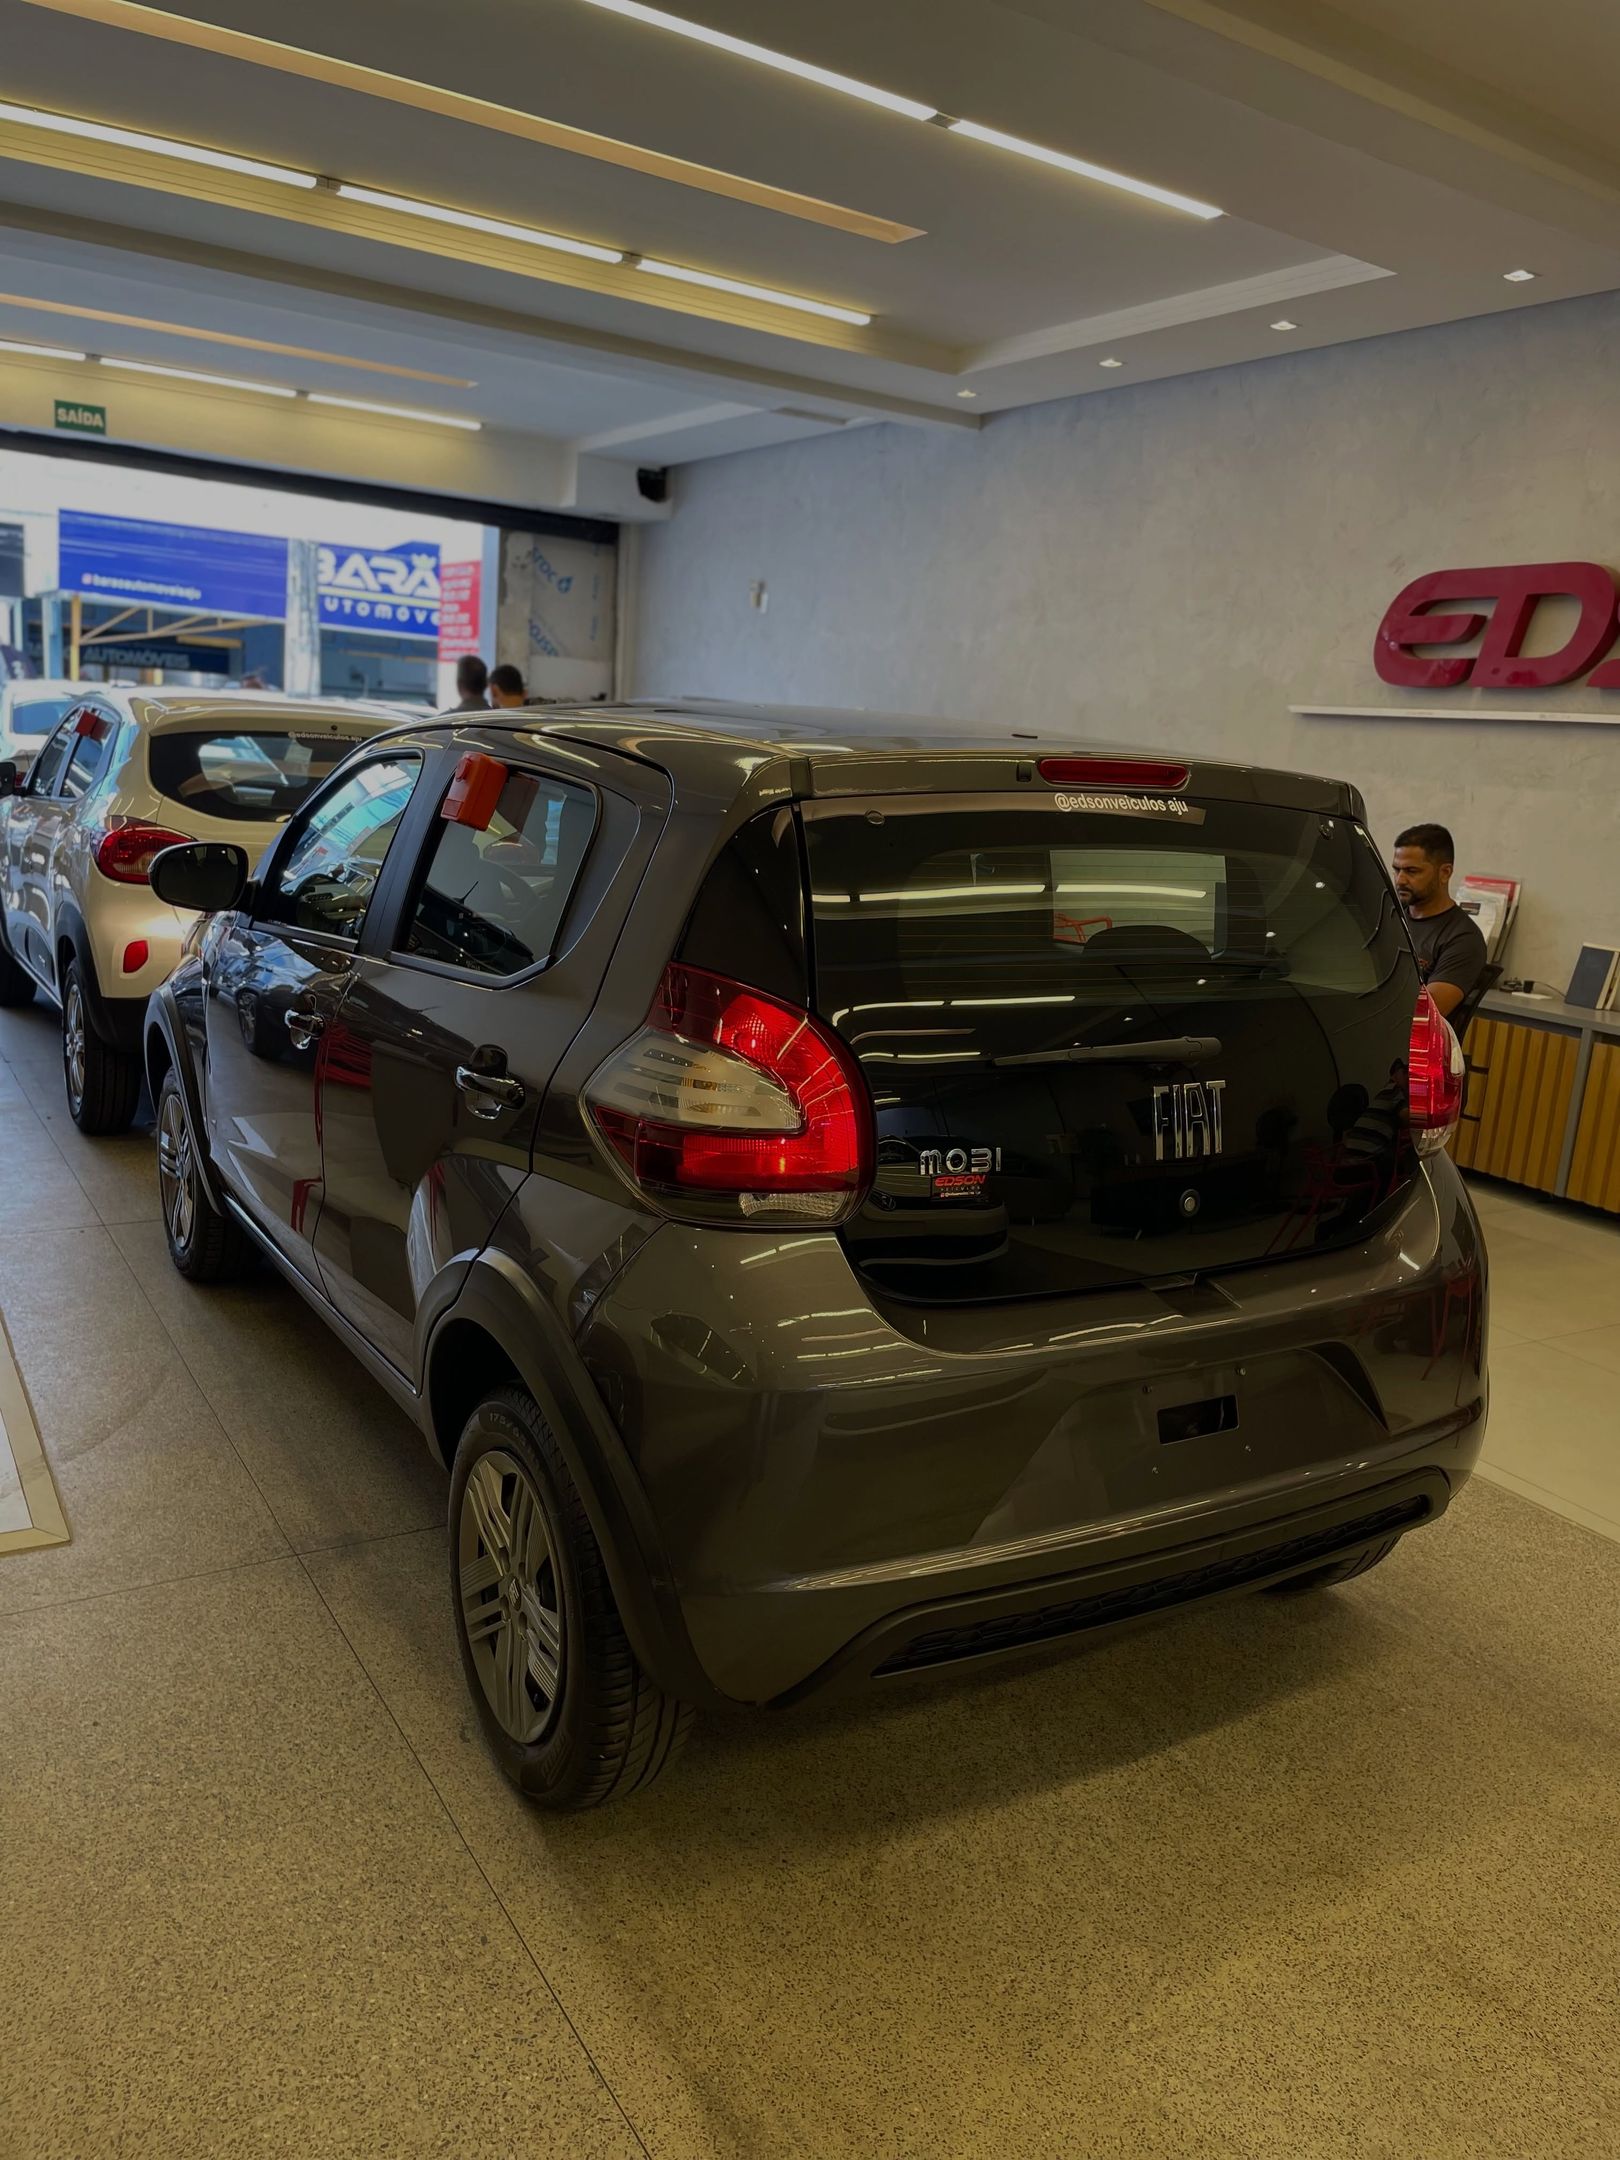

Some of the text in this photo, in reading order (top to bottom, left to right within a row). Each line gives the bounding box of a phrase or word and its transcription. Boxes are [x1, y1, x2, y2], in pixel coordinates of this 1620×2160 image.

[57, 407, 104, 428] SAÍDA
[1374, 561, 1620, 689] ED
[1054, 793, 1189, 815] @edsonveiculos aju
[1153, 1080, 1226, 1160] FIAT
[920, 1147, 1001, 1176] MOBI
[934, 1175, 986, 1187] EDSON
